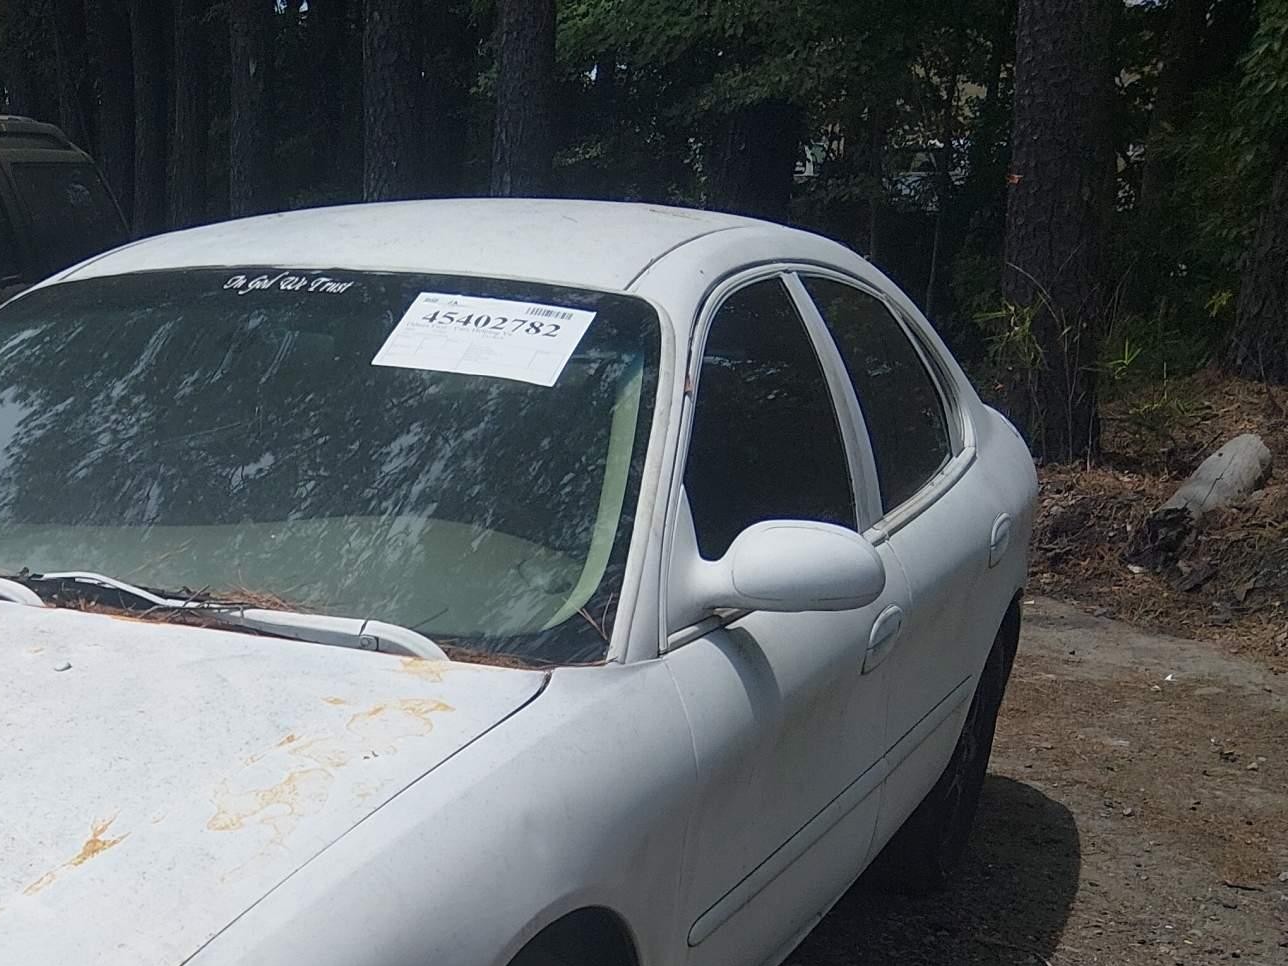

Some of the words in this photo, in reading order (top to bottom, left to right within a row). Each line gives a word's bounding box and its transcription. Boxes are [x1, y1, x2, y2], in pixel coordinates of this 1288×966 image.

[279, 276, 307, 290] We
[308, 277, 354, 293] Trust
[422, 310, 561, 338] 45402782
